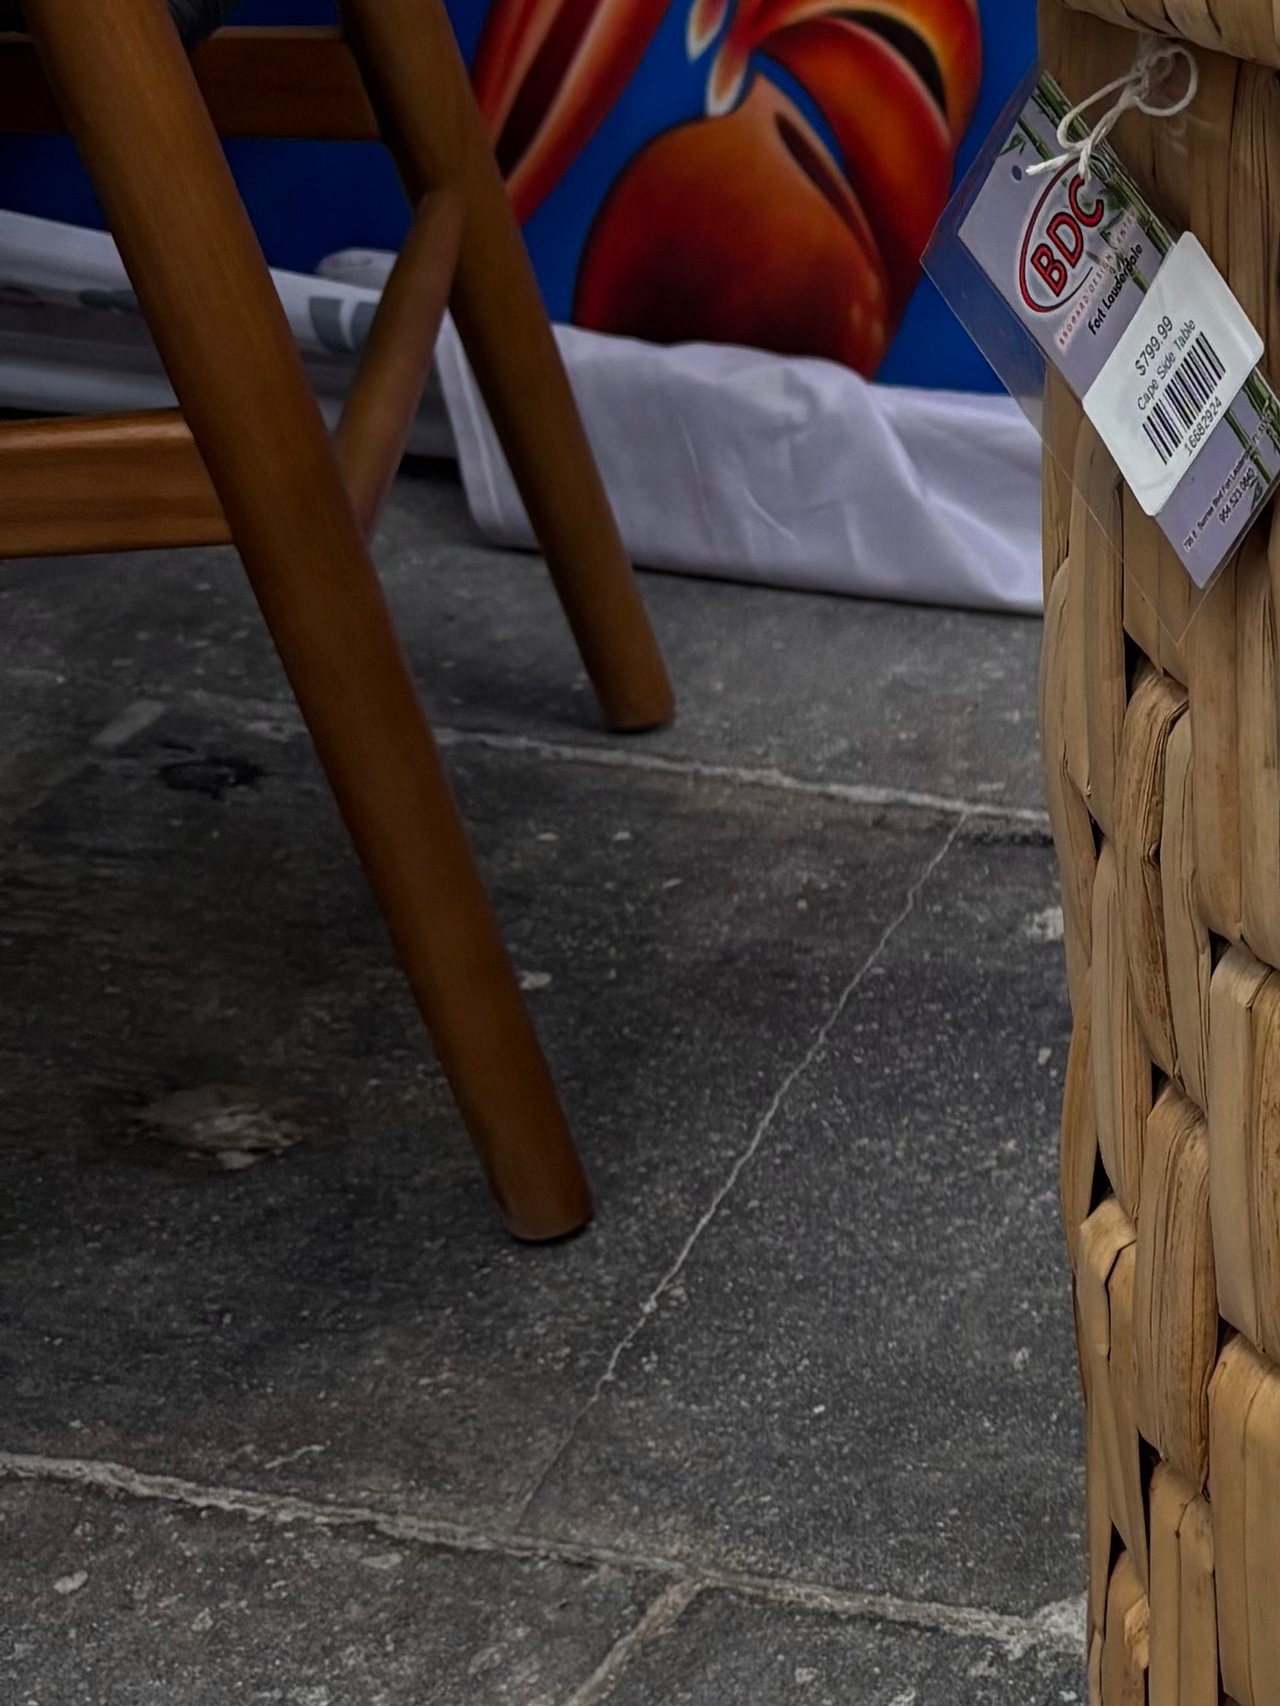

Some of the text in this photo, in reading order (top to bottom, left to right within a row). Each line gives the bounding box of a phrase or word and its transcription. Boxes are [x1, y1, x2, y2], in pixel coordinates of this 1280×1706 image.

[1031, 174, 1104, 298] BDC
[1088, 244, 1143, 336] Fort Lauderdale
[1134, 315, 1174, 377] $799.99
[1137, 319, 1196, 411] Cape Side Table
[1184, 396, 1222, 457] 16682924
